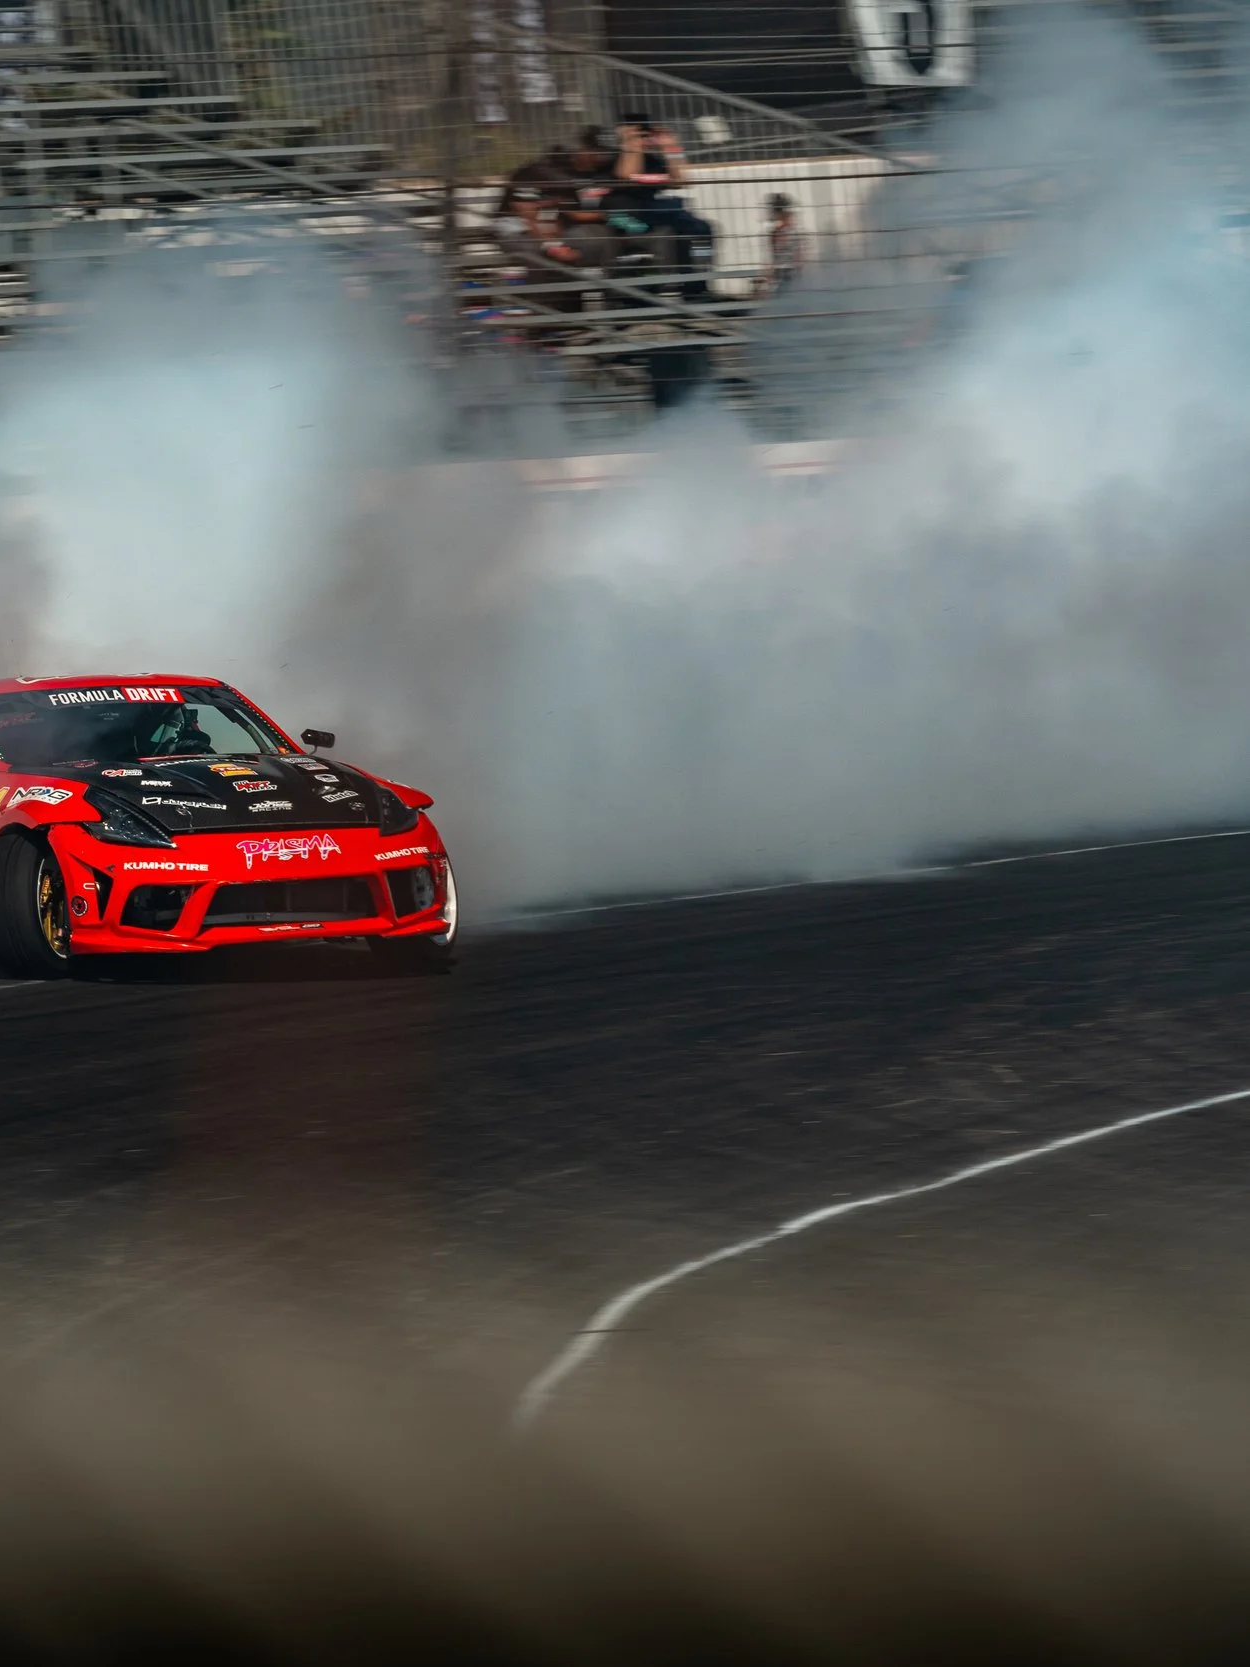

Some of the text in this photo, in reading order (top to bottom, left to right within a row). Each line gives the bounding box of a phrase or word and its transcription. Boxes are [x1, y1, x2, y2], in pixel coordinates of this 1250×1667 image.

[48, 687, 180, 706] FORMULA DRIFT
[236, 833, 342, 870] PRISMA
[374, 846, 430, 861] KUMHO TIRE
[123, 862, 209, 872] KUMHO TIRE
